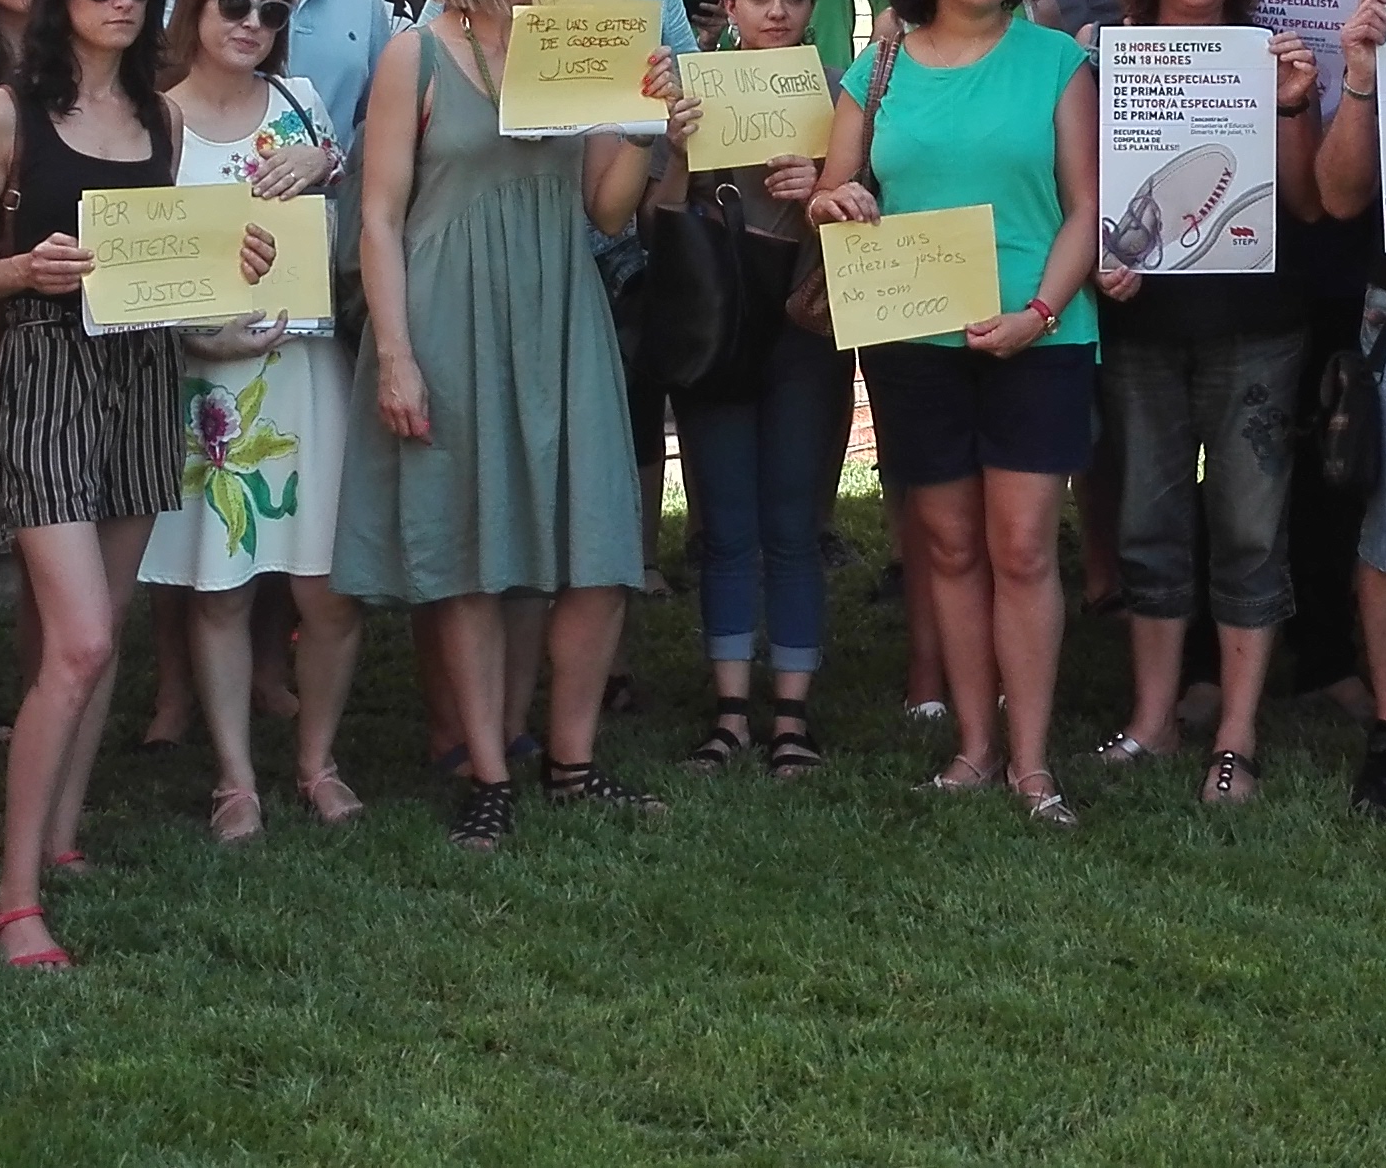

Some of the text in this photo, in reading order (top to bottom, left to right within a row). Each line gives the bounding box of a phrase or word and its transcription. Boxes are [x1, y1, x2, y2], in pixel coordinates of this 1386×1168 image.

[527, 14, 560, 33] PER
[567, 18, 588, 31] UNS
[541, 38, 559, 50] DE
[1115, 43, 1221, 52] 18 HORES LECTIVES
[1140, 56, 1151, 64] 18
[1155, 56, 1191, 64] HORES
[687, 62, 726, 98] PER
[735, 68, 767, 93] UNS
[1114, 75, 1240, 84] TUTOR/A ESPECIALISTA
[1114, 87, 1127, 95] DE
[1131, 99, 1177, 108] TUTOR/A
[1181, 99, 1257, 108] ESPECIALISTA
[1114, 112, 1127, 120] DE
[722, 106, 797, 146] JUSTOS
[91, 195, 187, 227] PER UNS
[1232, 237, 1259, 246] STEPV
[914, 246, 966, 278] justos
[124, 279, 214, 305] JUSTOS
